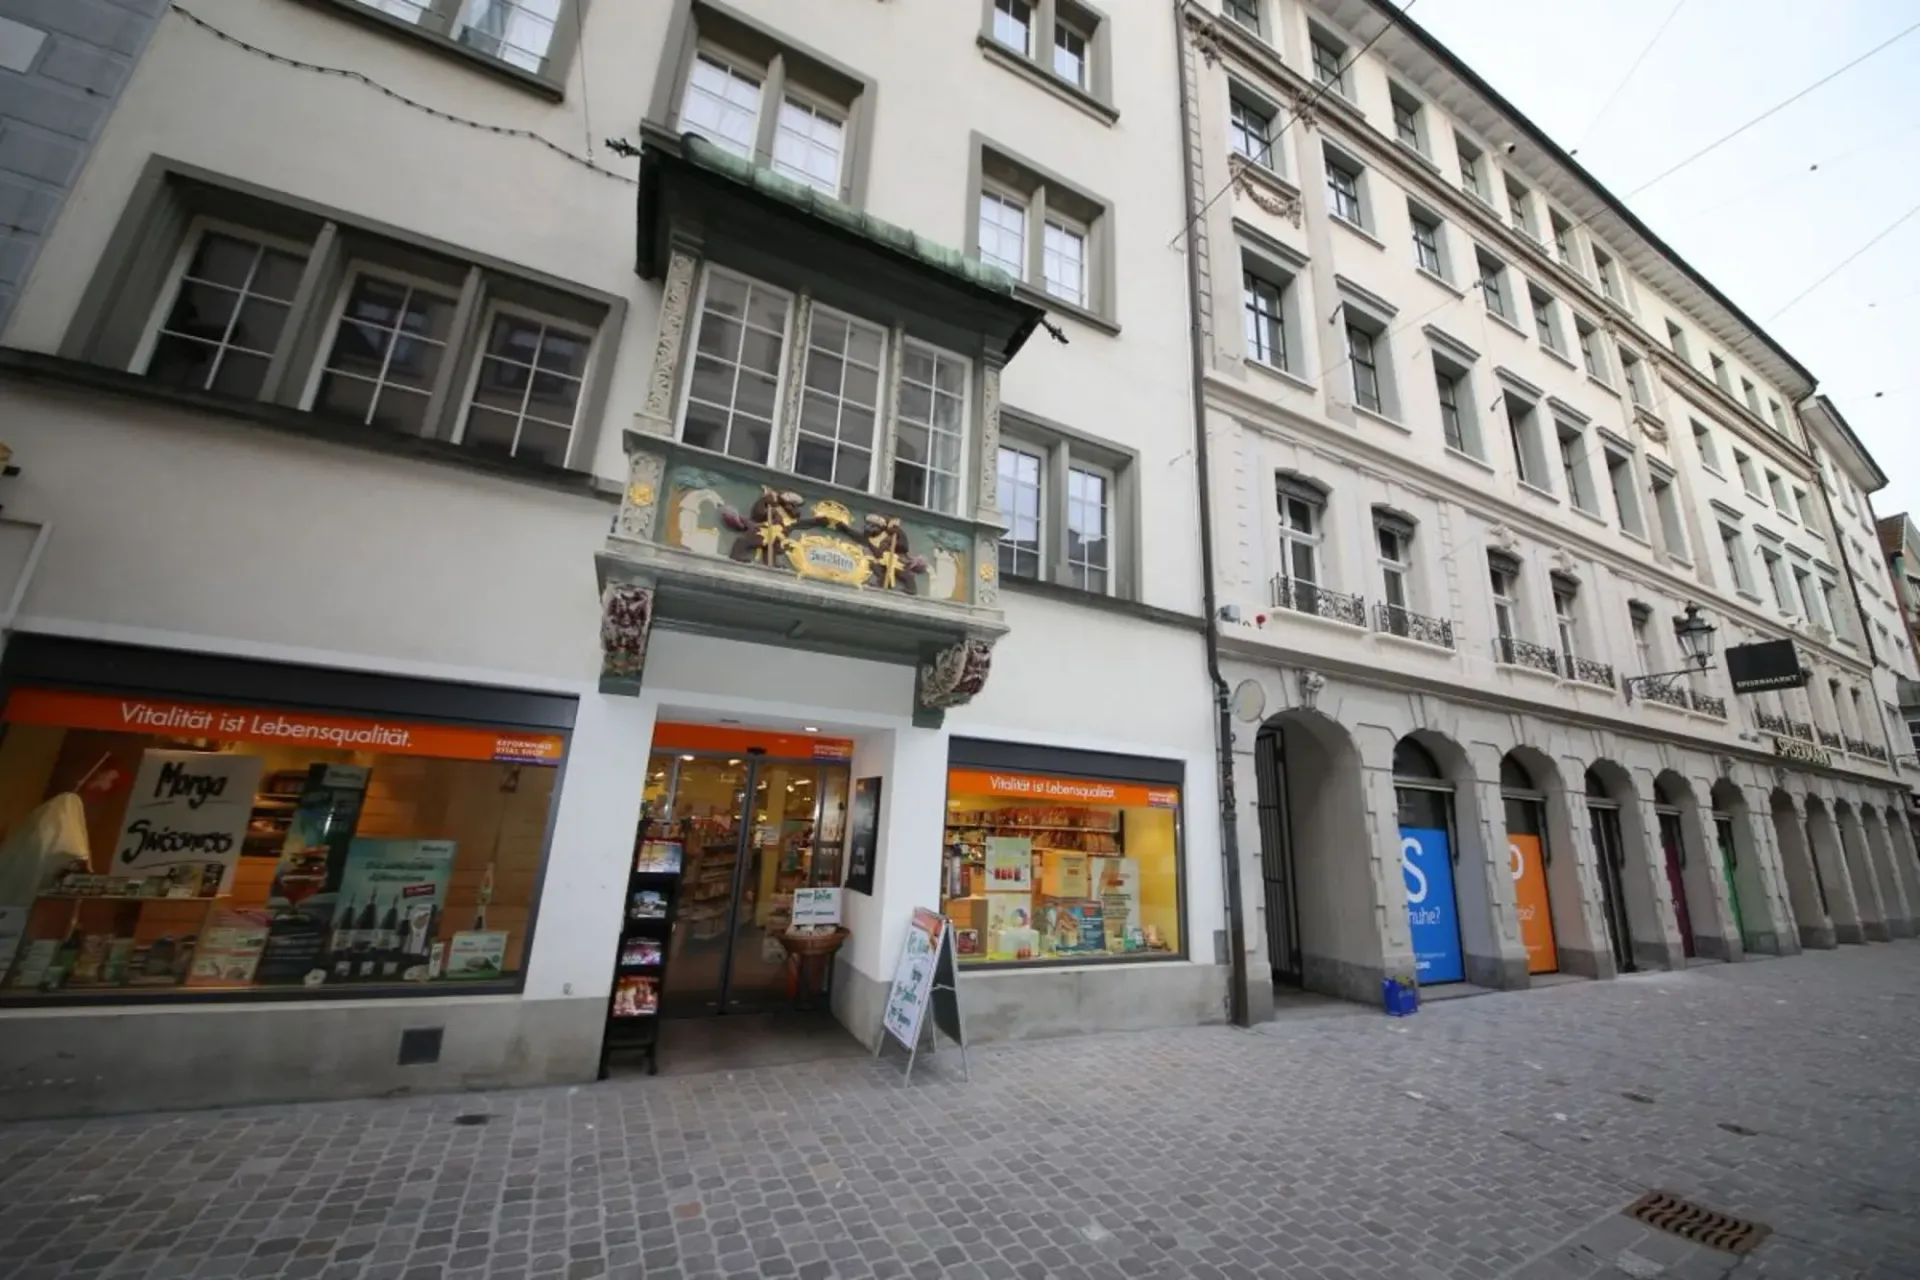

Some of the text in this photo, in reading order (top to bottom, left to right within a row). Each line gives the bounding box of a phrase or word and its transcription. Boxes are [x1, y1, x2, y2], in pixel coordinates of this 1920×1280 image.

[121, 702, 412, 747] Vitalität ist Lebensqualität.
[990, 774, 1030, 792] Vitalität
[1033, 780, 1044, 793] ist
